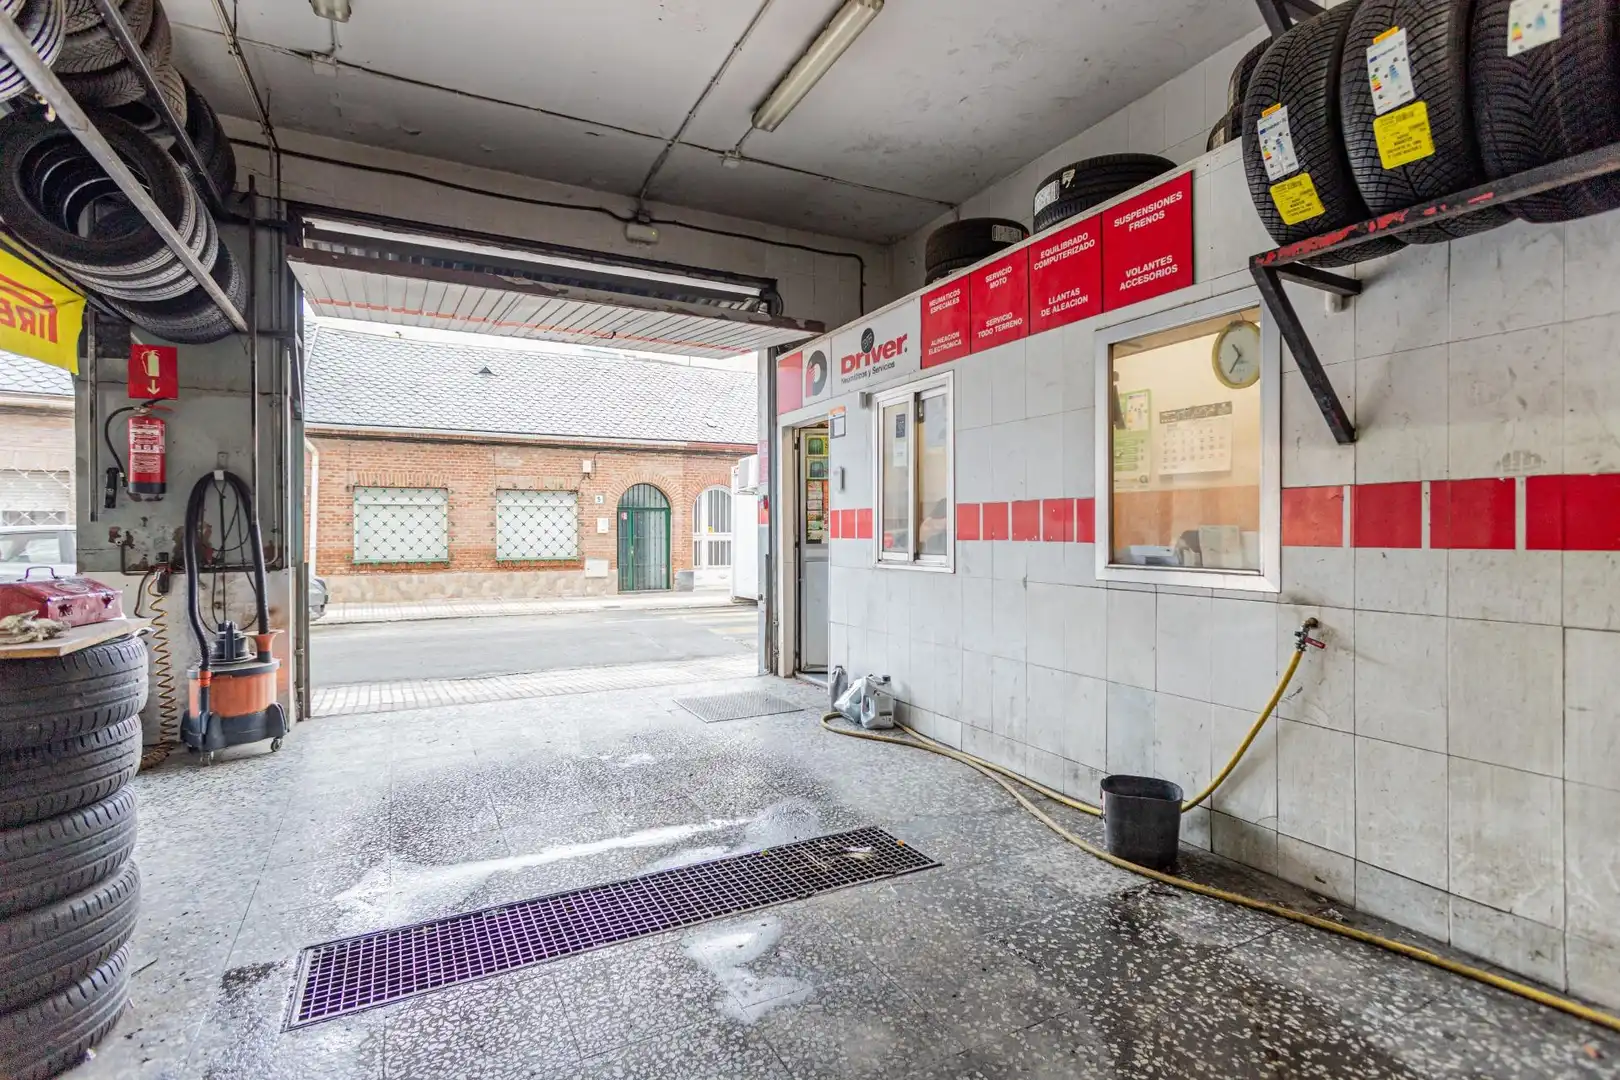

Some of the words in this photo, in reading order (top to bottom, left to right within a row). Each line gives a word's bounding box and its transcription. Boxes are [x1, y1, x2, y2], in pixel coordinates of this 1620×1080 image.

[1114, 191, 1183, 228] SUSPENSIONES
[1129, 210, 1165, 232] FRENOS
[1033, 239, 1095, 271] COMPUTERIZADO
[1040, 232, 1089, 259] EQUILIBRADO
[985, 266, 1012, 283] SERVICIO
[1125, 254, 1173, 278] VOLANTES
[989, 276, 1007, 289] MOTO
[1119, 264, 1178, 291] ACCESORIOS
[930, 296, 960, 314] ESPECIALES
[1048, 287, 1081, 305] LLANTAS
[1040, 306, 1051, 317] DE
[1052, 295, 1088, 314] ALEACION
[977, 328, 993, 338] TODO
[995, 317, 1023, 333] TERRENO
[986, 312, 1012, 327] SERVICIO
[928, 338, 962, 355] ELECTRONICA
[931, 331, 960, 346] ALINEACION
[872, 360, 895, 375] Servicios
